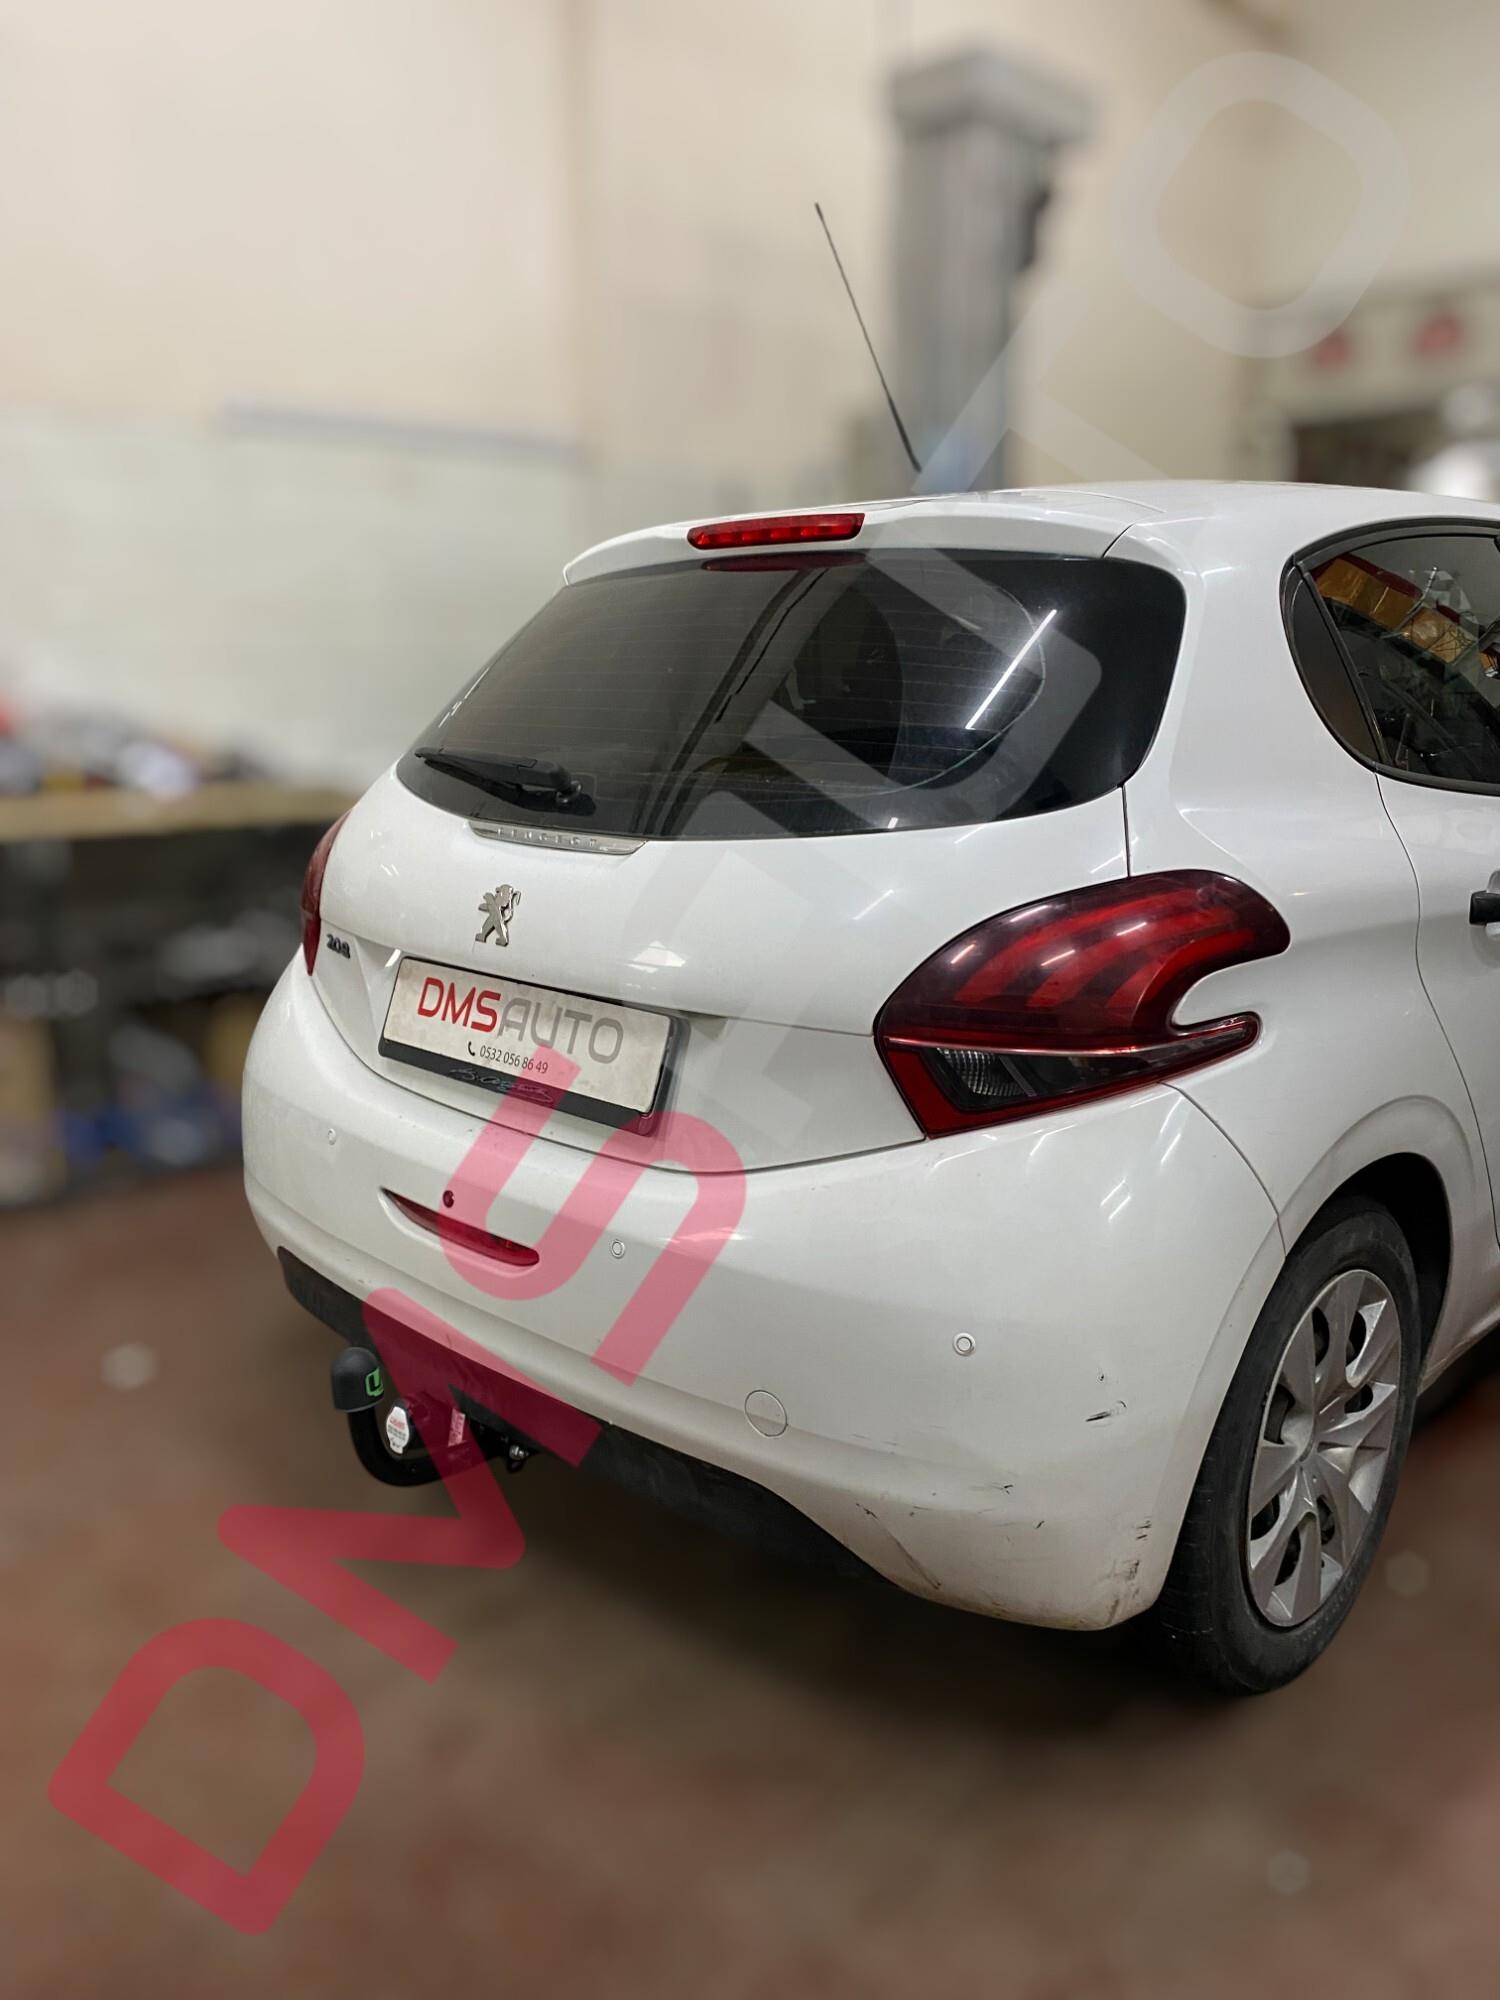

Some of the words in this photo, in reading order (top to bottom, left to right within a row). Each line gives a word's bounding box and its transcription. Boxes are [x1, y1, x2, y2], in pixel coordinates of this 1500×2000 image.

[326, 933, 351, 960] 208
[416, 976, 624, 1064] DMSAUTO
[480, 1045, 502, 1062] 0532
[503, 1051, 521, 1067] 056
[521, 1056, 535, 1071] 86
[535, 1060, 549, 1074] 49
